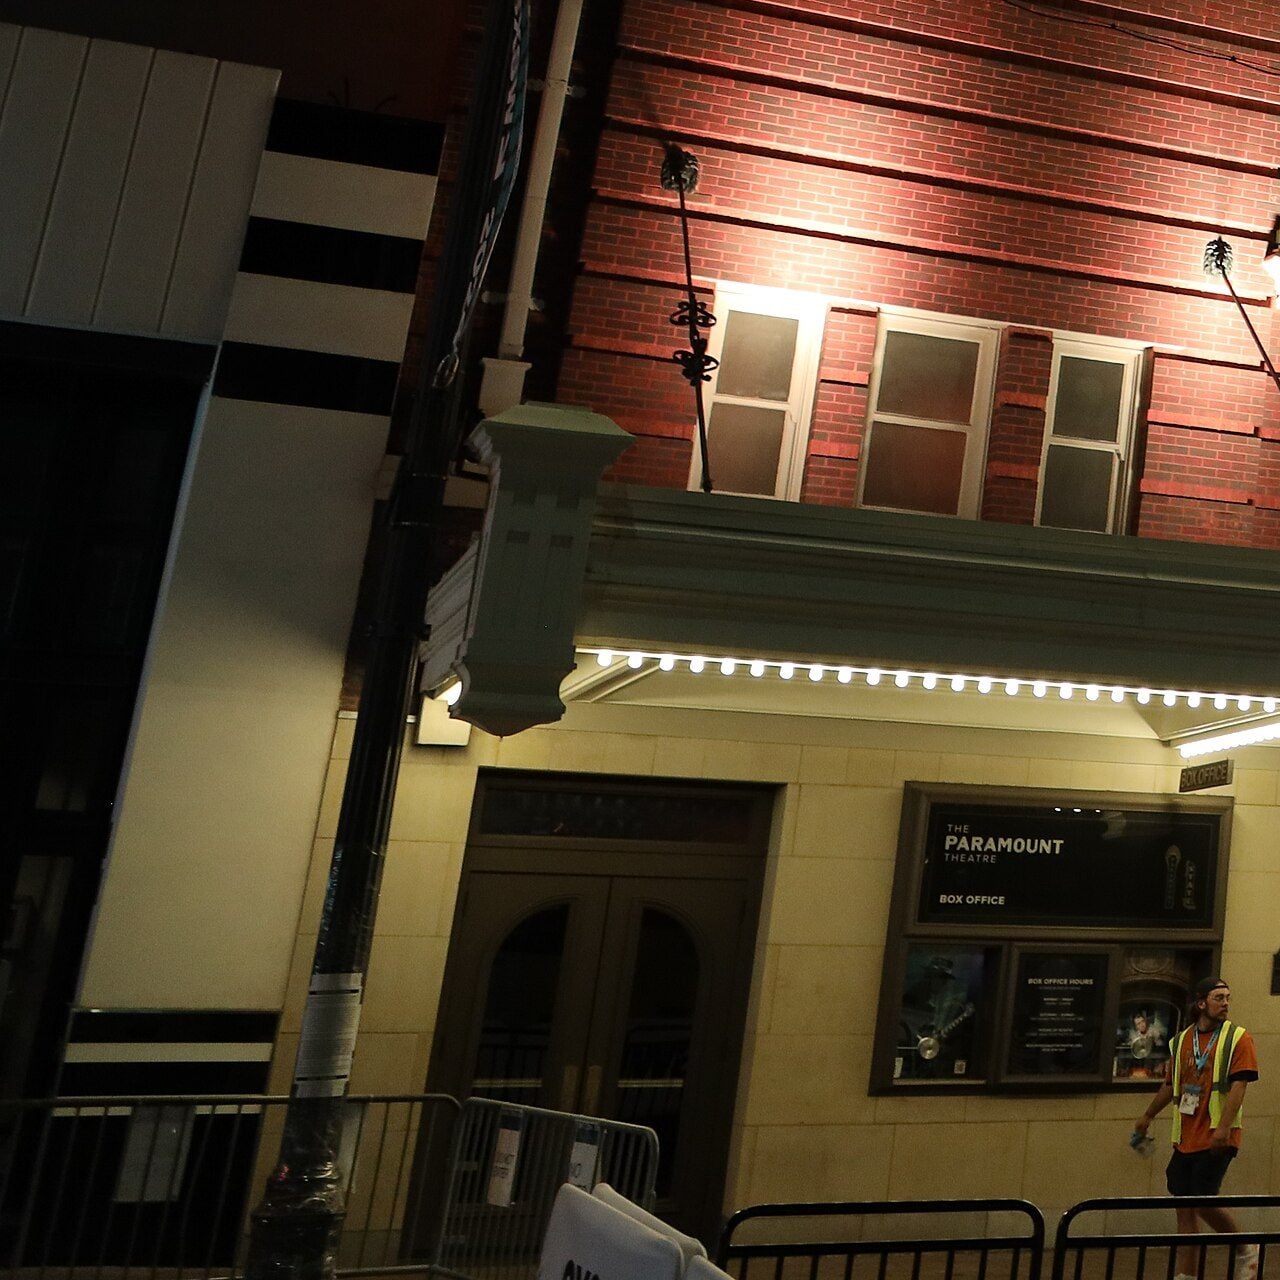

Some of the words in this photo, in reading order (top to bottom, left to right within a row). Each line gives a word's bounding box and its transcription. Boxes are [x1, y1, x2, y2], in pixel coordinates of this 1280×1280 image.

[1181, 769, 1197, 787] BOX
[1198, 761, 1228, 785] OFFICE
[947, 824, 969, 833] THE
[944, 835, 1065, 855] PARAMOUNT
[944, 853, 997, 864] THEATRE
[939, 894, 963, 905] BOX
[965, 894, 1005, 906] OFFICE
[1027, 977, 1042, 985] BOX
